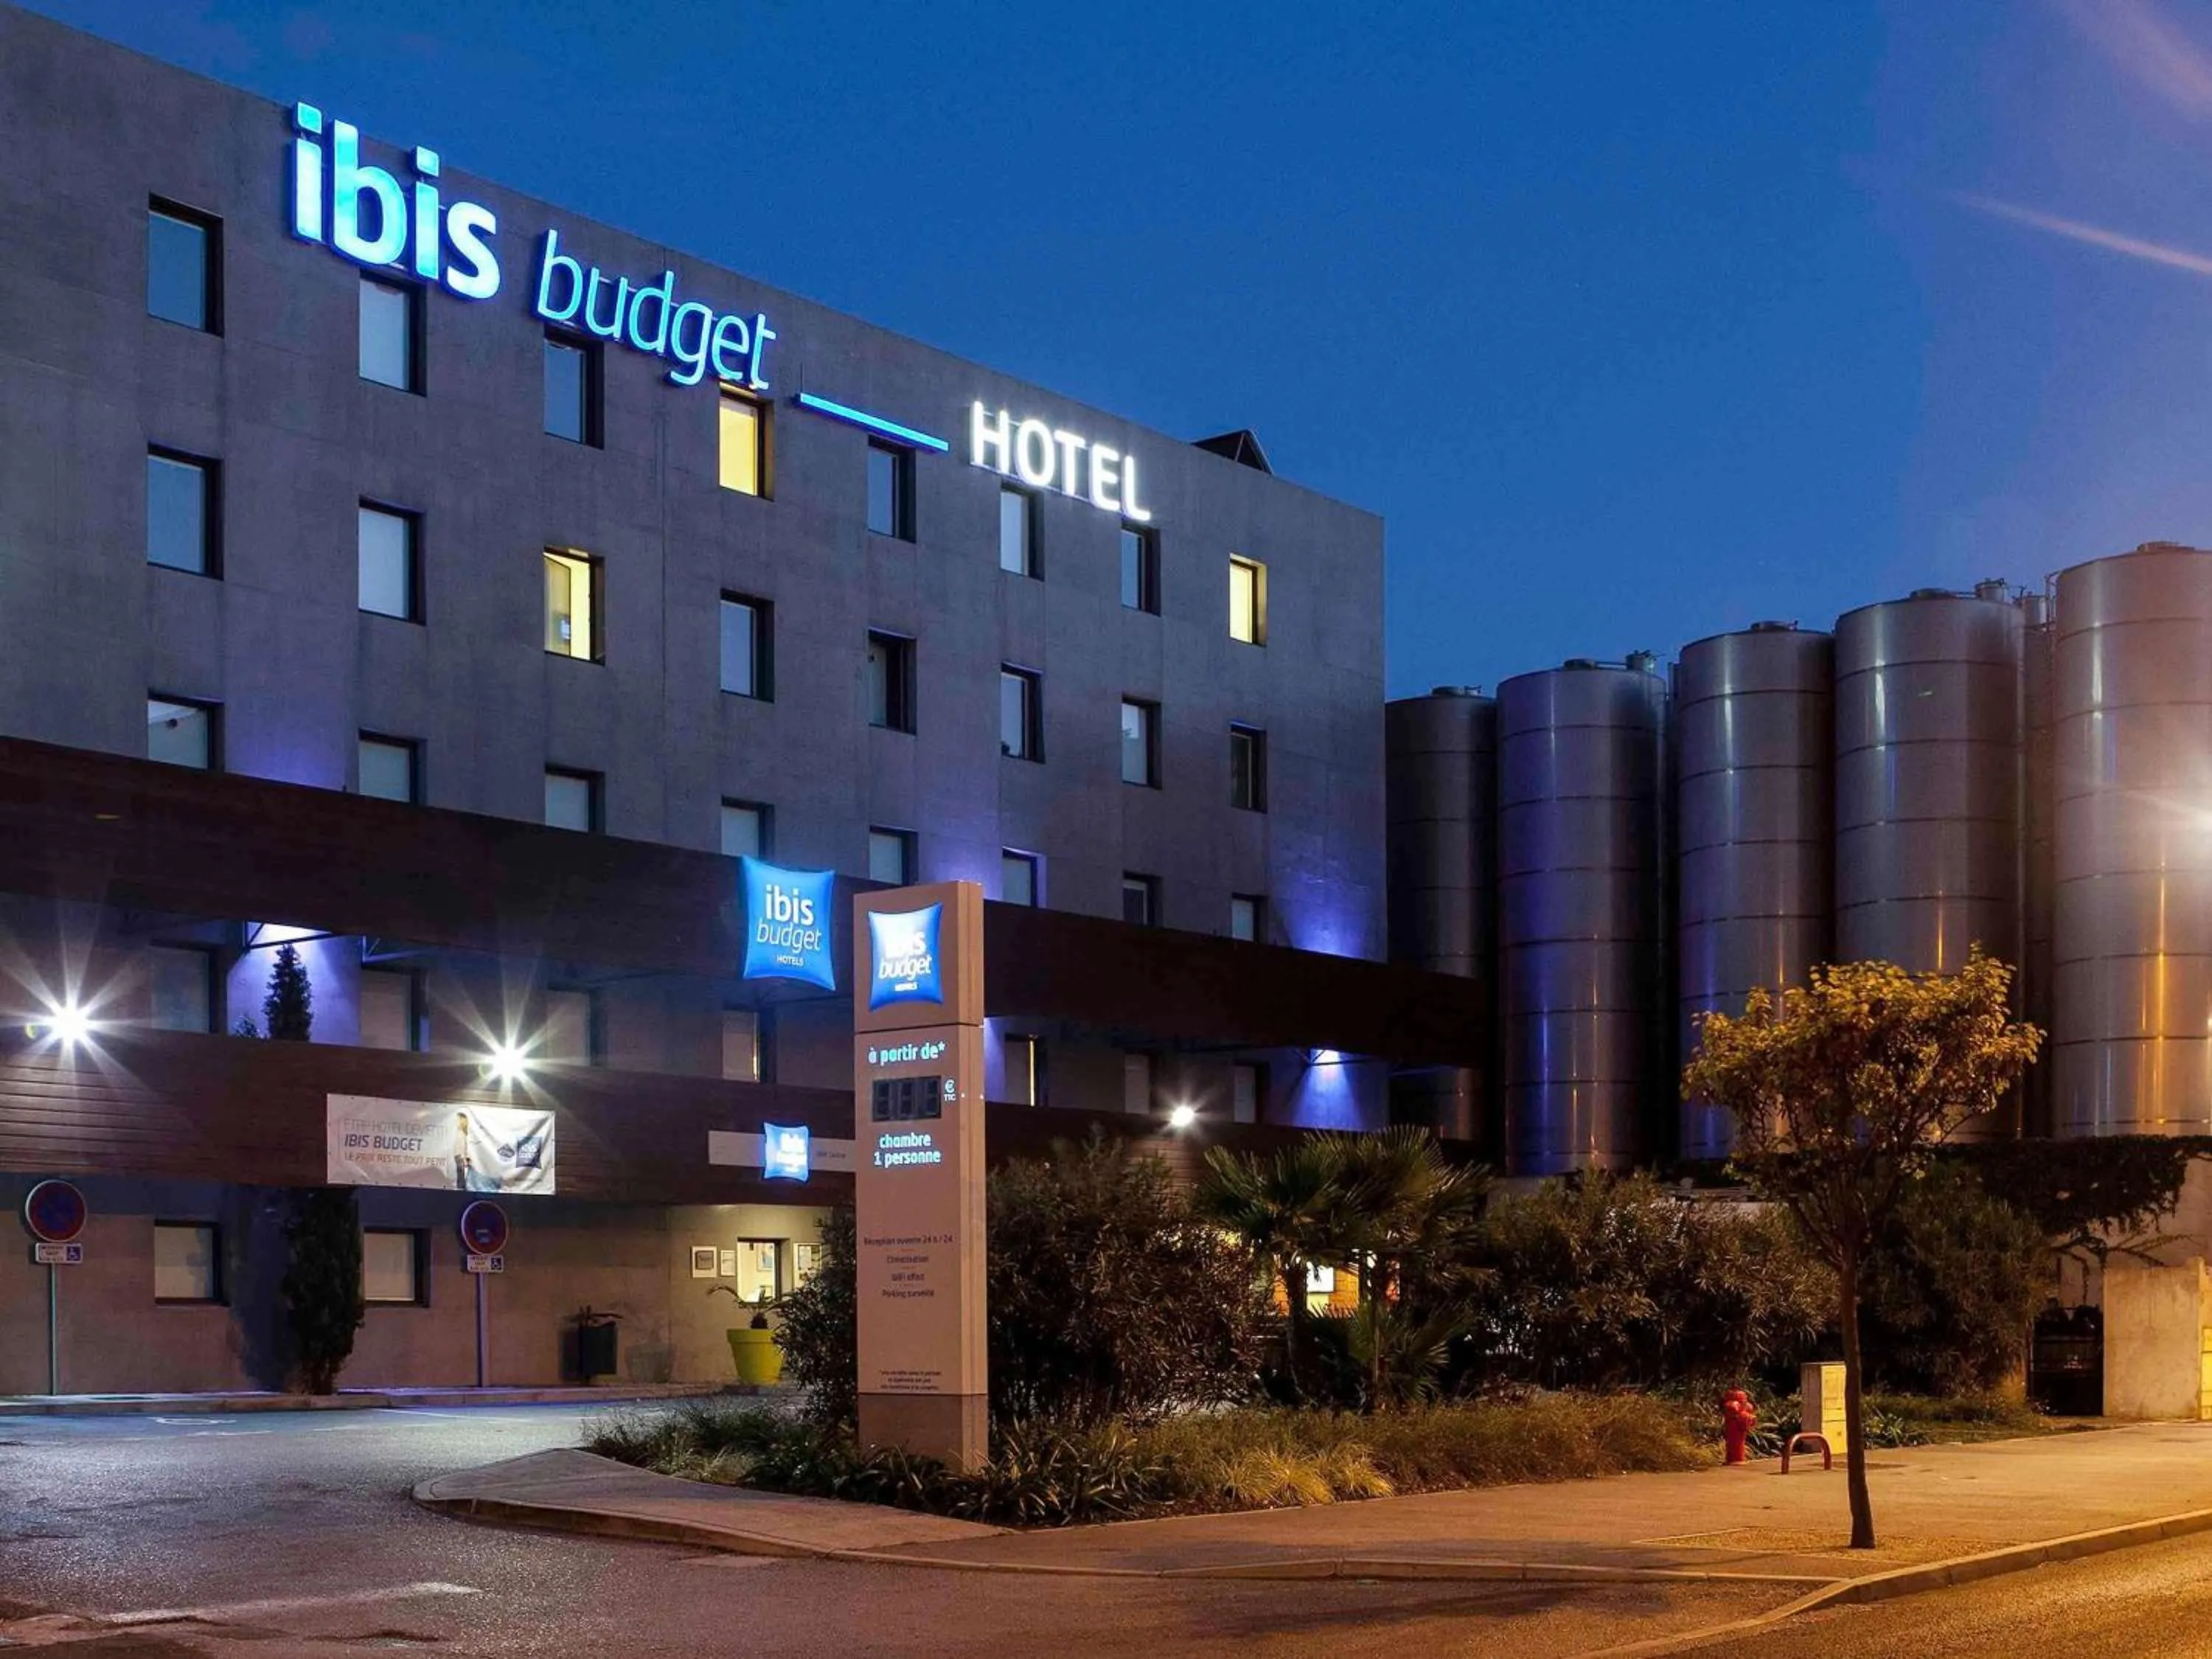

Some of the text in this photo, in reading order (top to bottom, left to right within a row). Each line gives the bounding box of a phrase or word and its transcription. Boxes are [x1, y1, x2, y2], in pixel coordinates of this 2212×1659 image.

[294, 101, 777, 391] ibis budget
[970, 400, 1151, 521] HOTEL
[765, 884, 815, 926] ibis
[757, 917, 822, 953] budget
[776, 955, 804, 967] HOTELS
[878, 955, 933, 981] budget
[868, 1046, 877, 1064] à
[880, 1043, 918, 1067] partir
[945, 1079, 956, 1093] €
[344, 1133, 424, 1151] IBIS BUDGET
[879, 1133, 931, 1149] chambre
[874, 1150, 942, 1168] 1 personne
[922, 1234, 931, 1244] 24
[944, 1234, 953, 1244] 24
